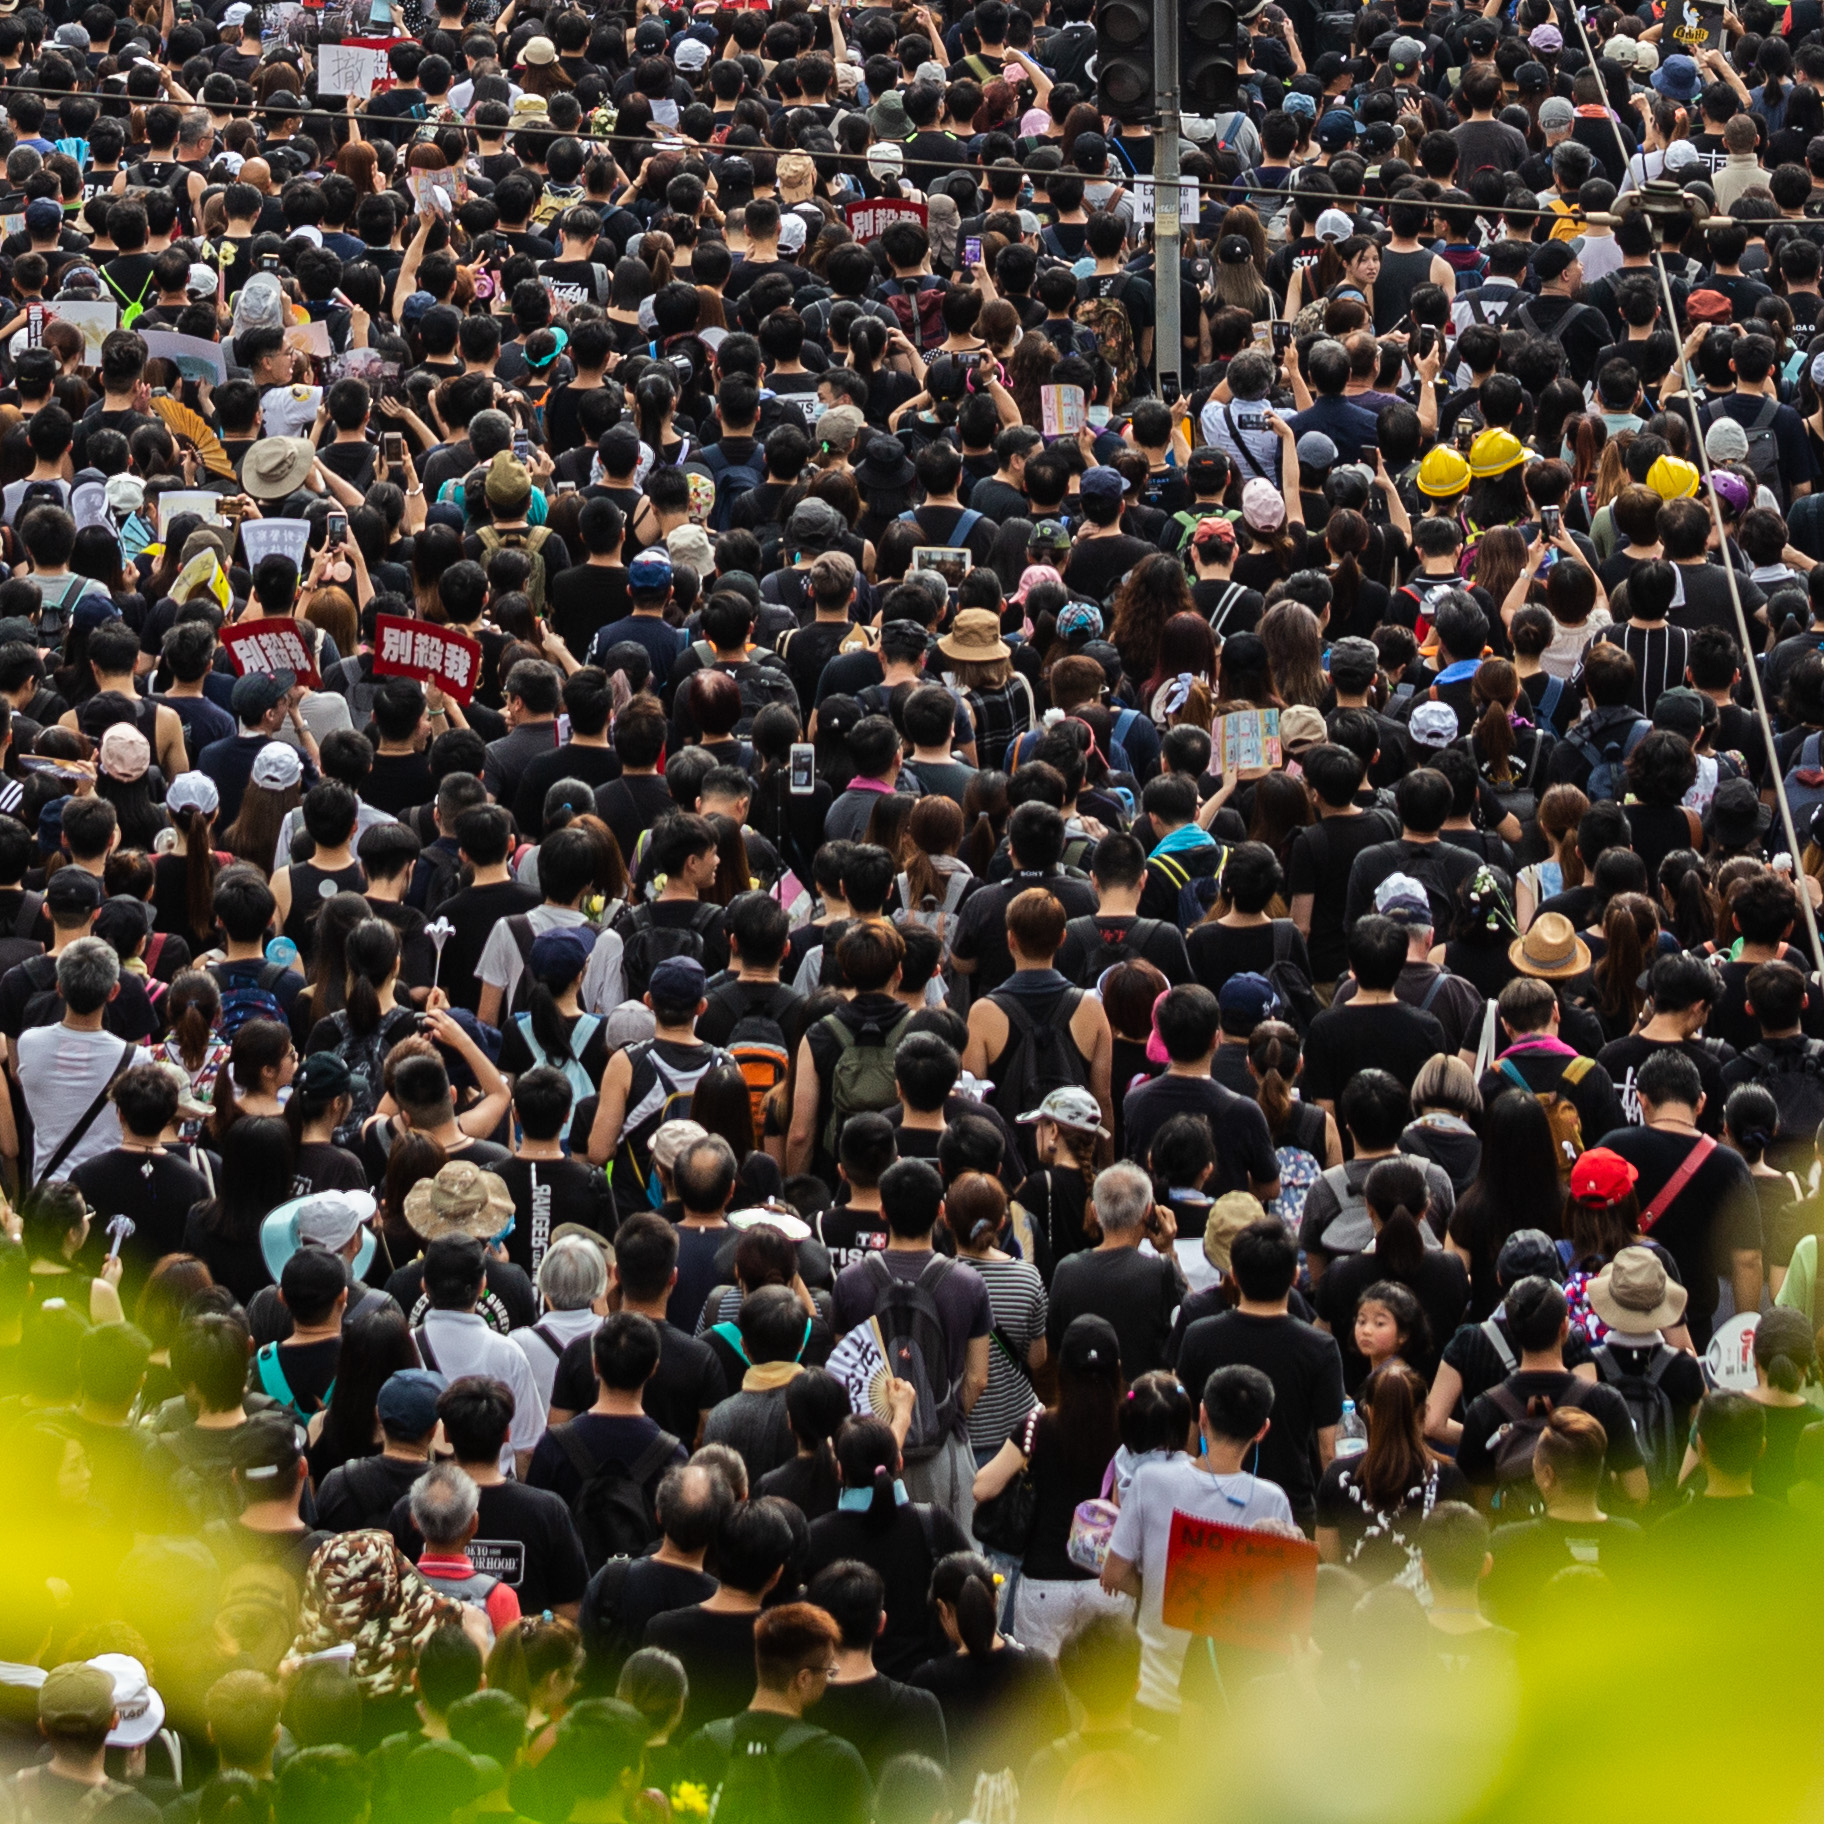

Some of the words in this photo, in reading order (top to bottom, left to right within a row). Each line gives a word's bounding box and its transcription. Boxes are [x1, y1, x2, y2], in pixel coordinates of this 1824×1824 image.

[332, 47, 367, 91] 撤
[231, 633, 312, 677] 別殺我
[382, 626, 471, 688] 別殺我
[486, 1293, 510, 1337] SWEET
[464, 1545, 488, 1557] OKYO
